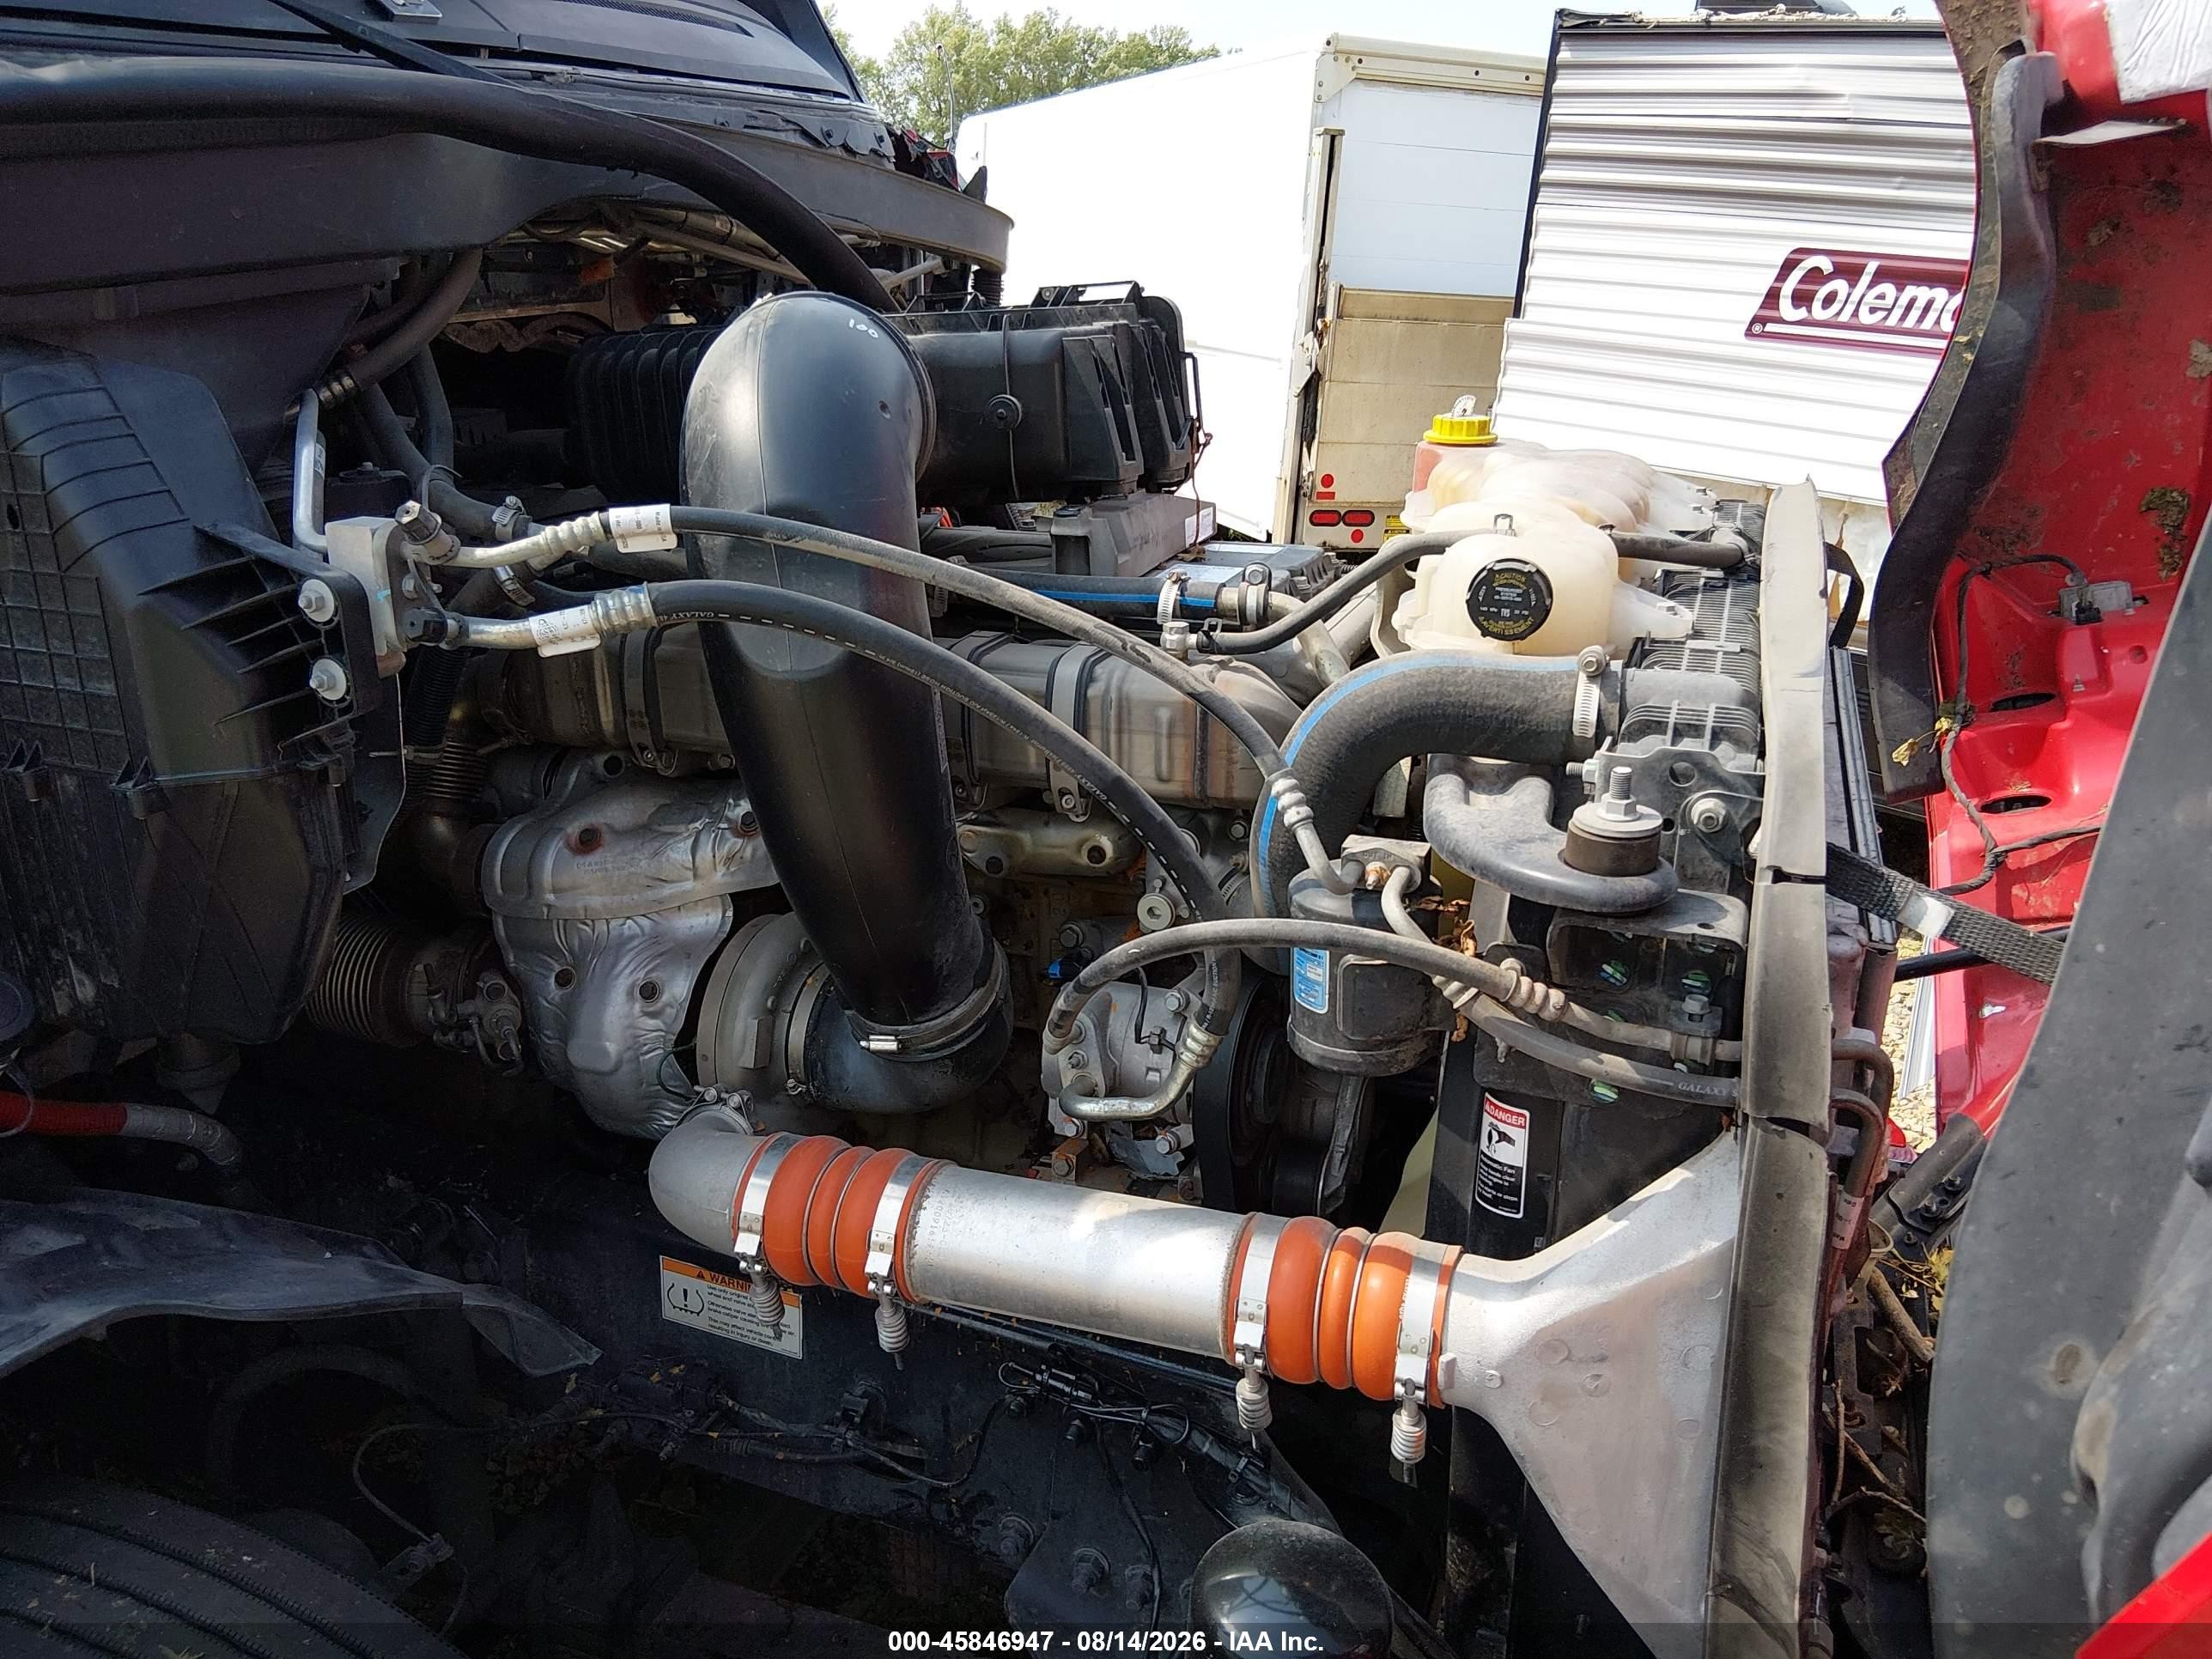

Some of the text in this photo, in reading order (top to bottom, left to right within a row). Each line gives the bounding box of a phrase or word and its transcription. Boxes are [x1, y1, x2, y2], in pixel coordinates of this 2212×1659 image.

[921, 674, 941, 688] HOSE
[941, 684, 969, 702] SUCTION
[1074, 775, 1108, 801] GALAXY
[1678, 1081, 1728, 1096] GALAXY
[1490, 1108, 1526, 1127] DANGER
[708, 1323, 730, 1334] resulting
